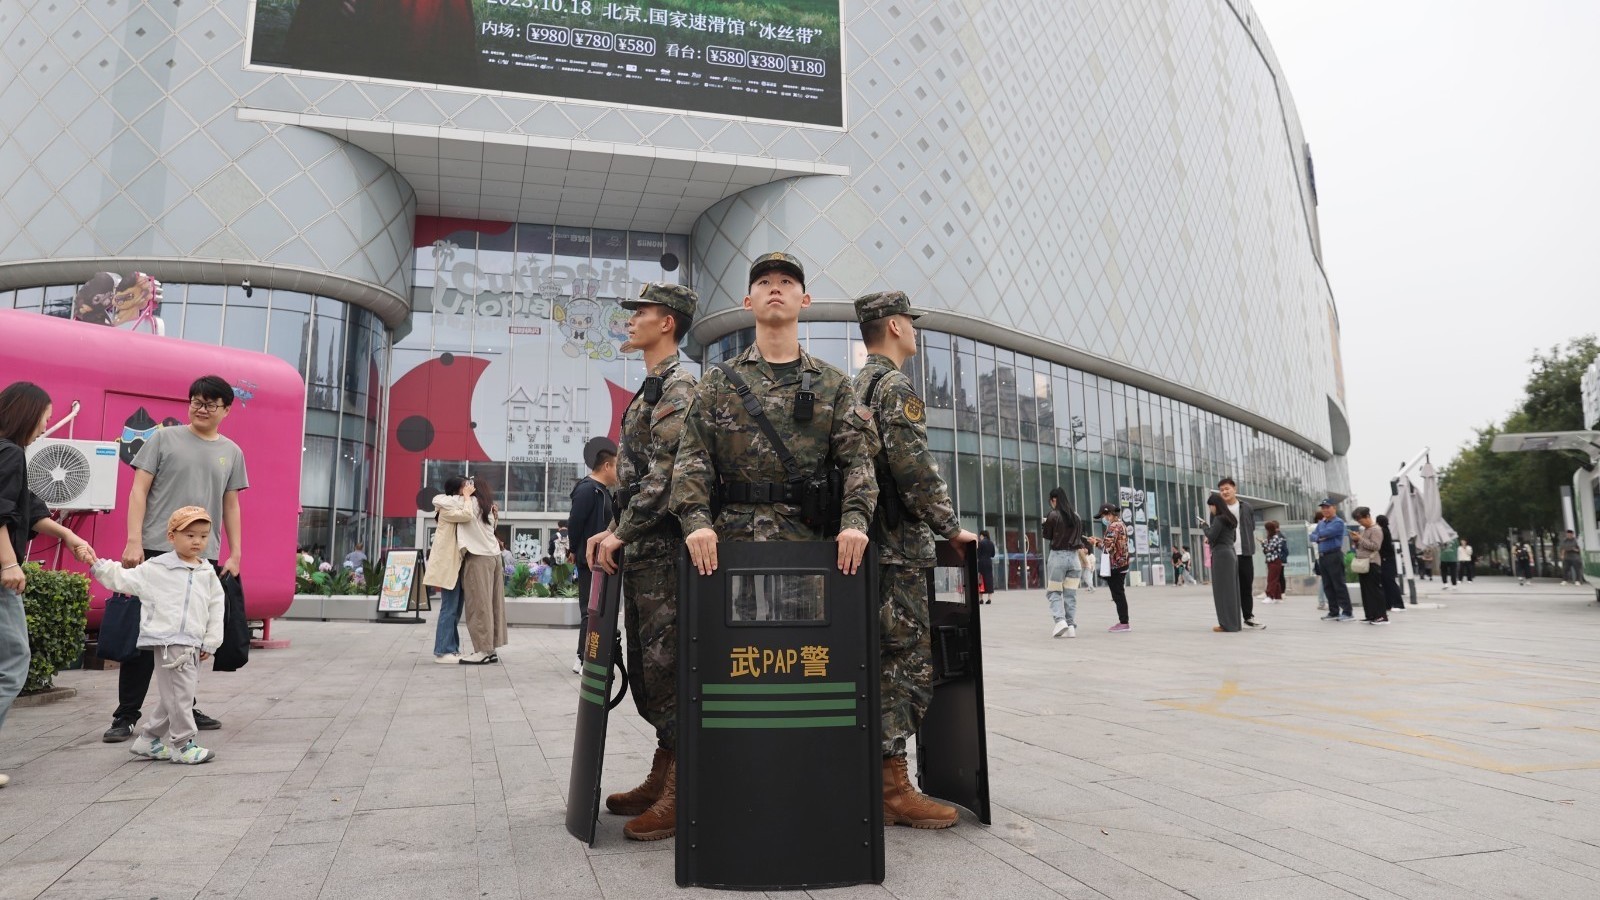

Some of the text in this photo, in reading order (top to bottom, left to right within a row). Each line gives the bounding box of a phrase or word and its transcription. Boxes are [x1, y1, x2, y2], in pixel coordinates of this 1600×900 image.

[487, 0, 591, 15] 3.10.18
[531, 27, 567, 43] ¥980
[574, 32, 611, 49] ¥780
[618, 38, 653, 54] ¥580
[710, 49, 744, 65] ¥580
[750, 54, 784, 70] ¥380
[791, 60, 823, 75] ¥180
[430, 277, 550, 318] Utopia
[502, 385, 590, 424] 合生汇
